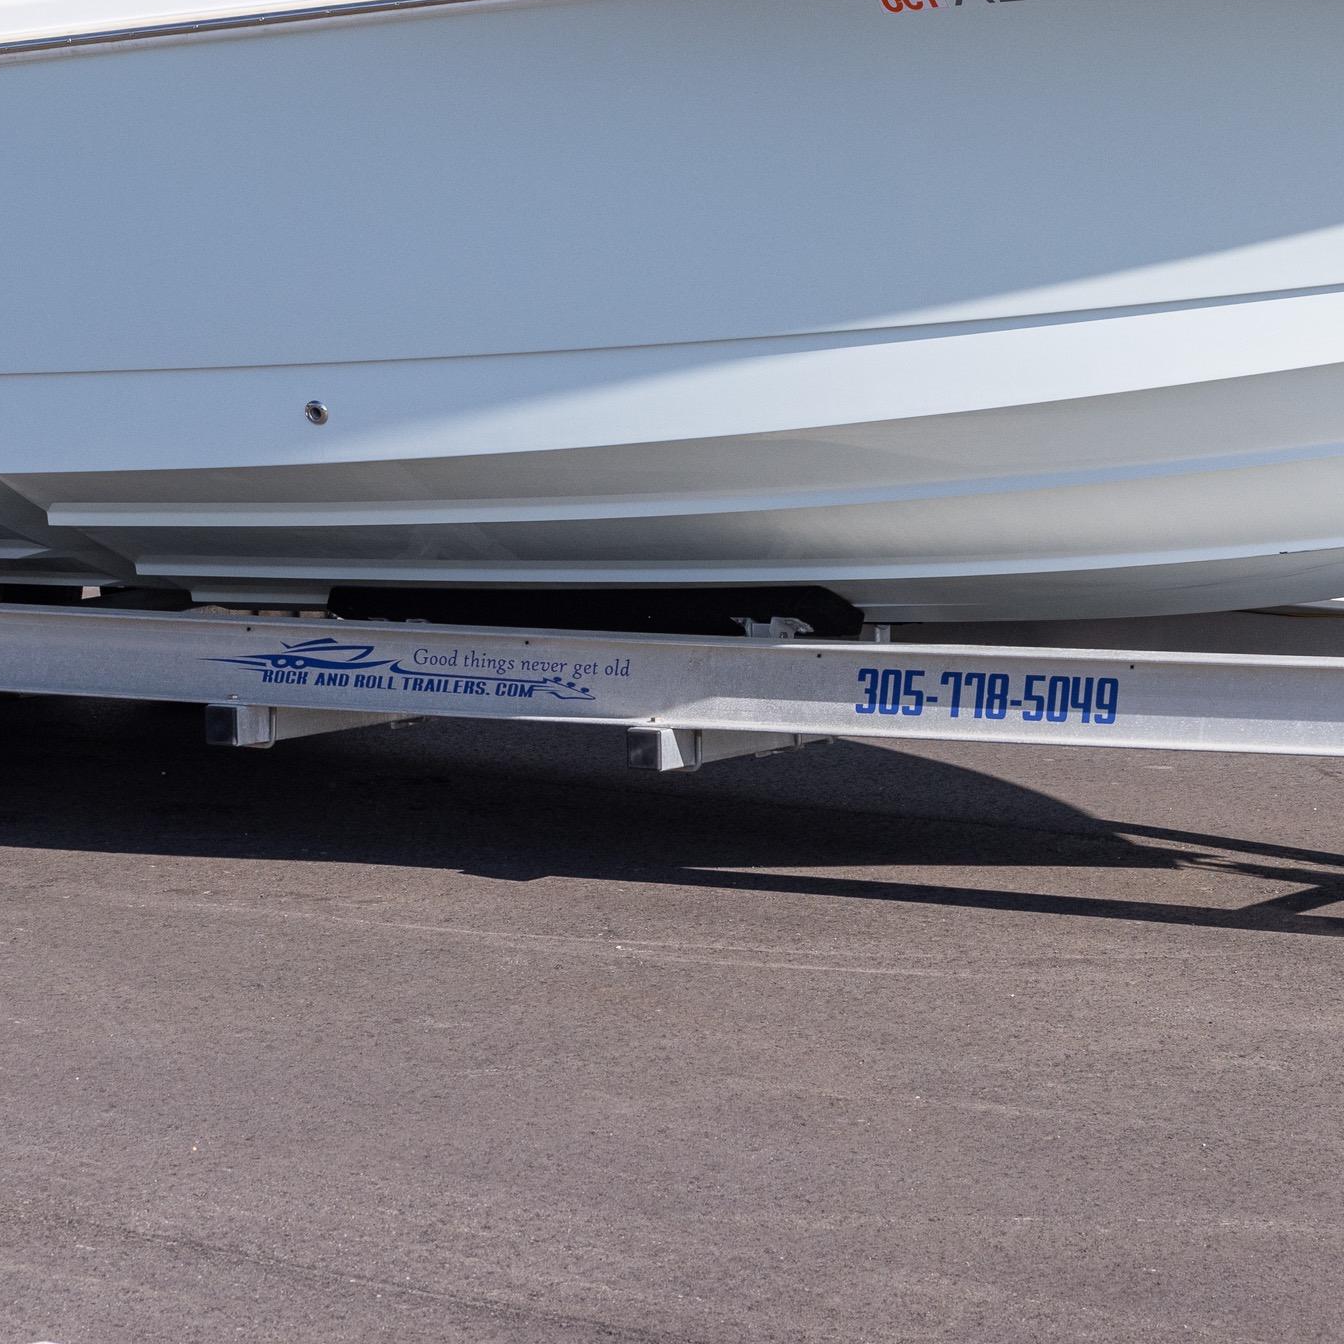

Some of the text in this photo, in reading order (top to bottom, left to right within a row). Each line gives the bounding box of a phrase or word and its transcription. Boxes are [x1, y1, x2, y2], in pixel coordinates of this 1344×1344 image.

[261, 669, 309, 687] ROCK
[314, 672, 349, 688] AND
[353, 674, 396, 690] ROLL
[413, 648, 631, 680] Good things never get old
[854, 667, 1120, 725] 305-778-5049
